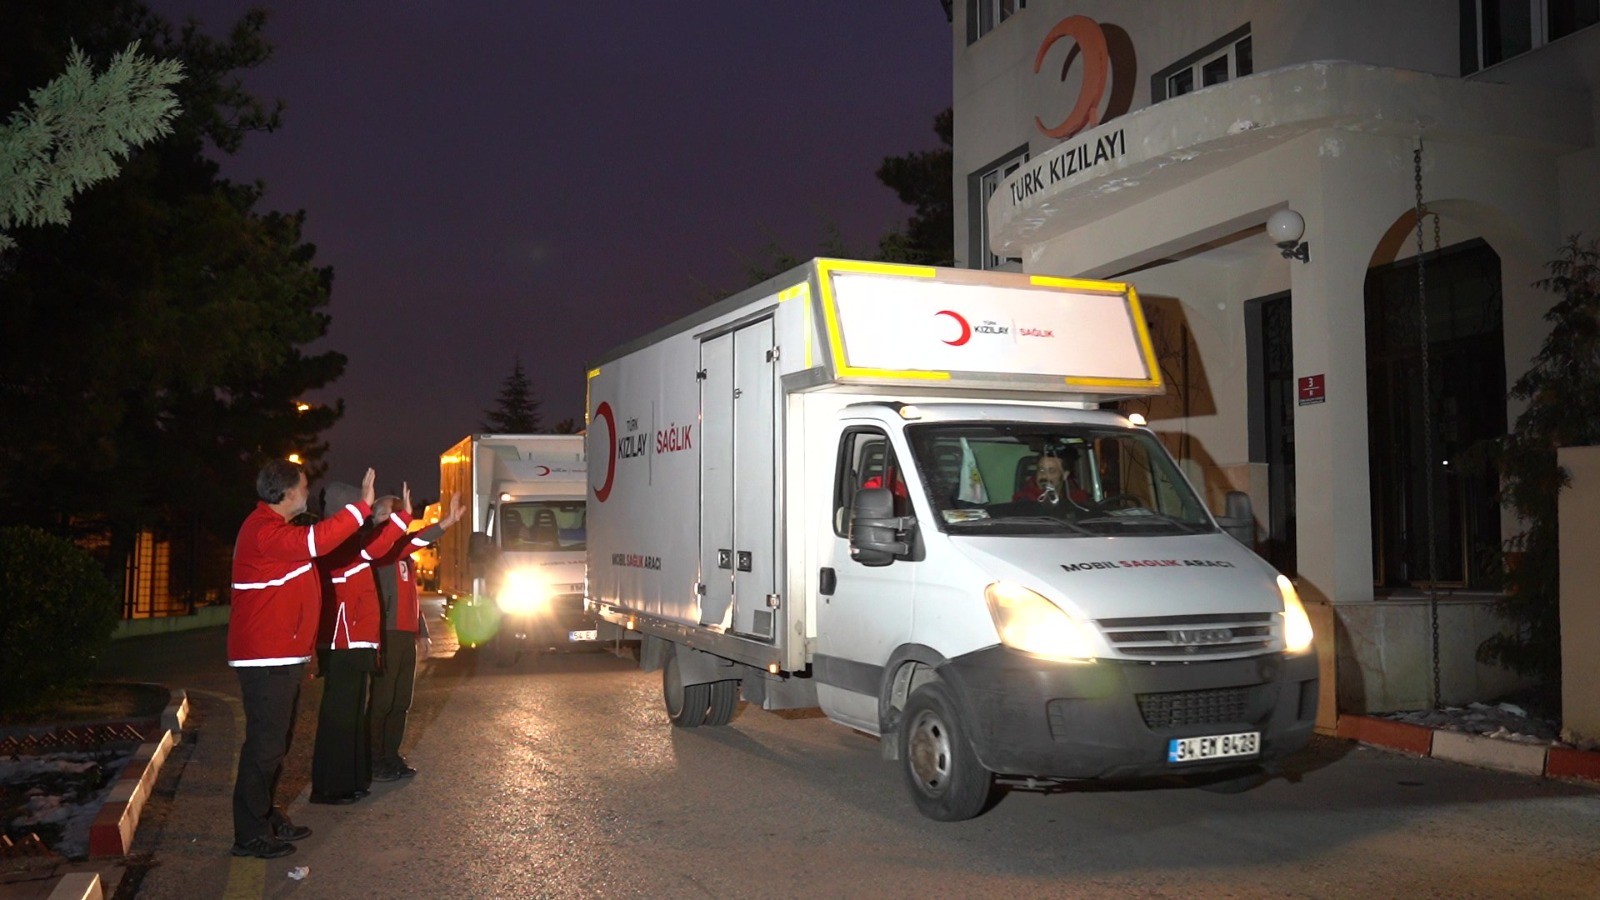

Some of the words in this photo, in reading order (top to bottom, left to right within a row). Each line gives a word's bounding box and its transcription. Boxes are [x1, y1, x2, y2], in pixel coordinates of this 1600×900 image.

[1050, 128, 1126, 184] KIZILAYI
[974, 326, 1008, 334] KIZILAY
[1308, 377, 1314, 387] 3
[618, 433, 647, 459] KIZILAY
[656, 422, 692, 454] SAĞLIK
[1183, 560, 1236, 568] ARACI
[1178, 741, 1195, 759] 34
